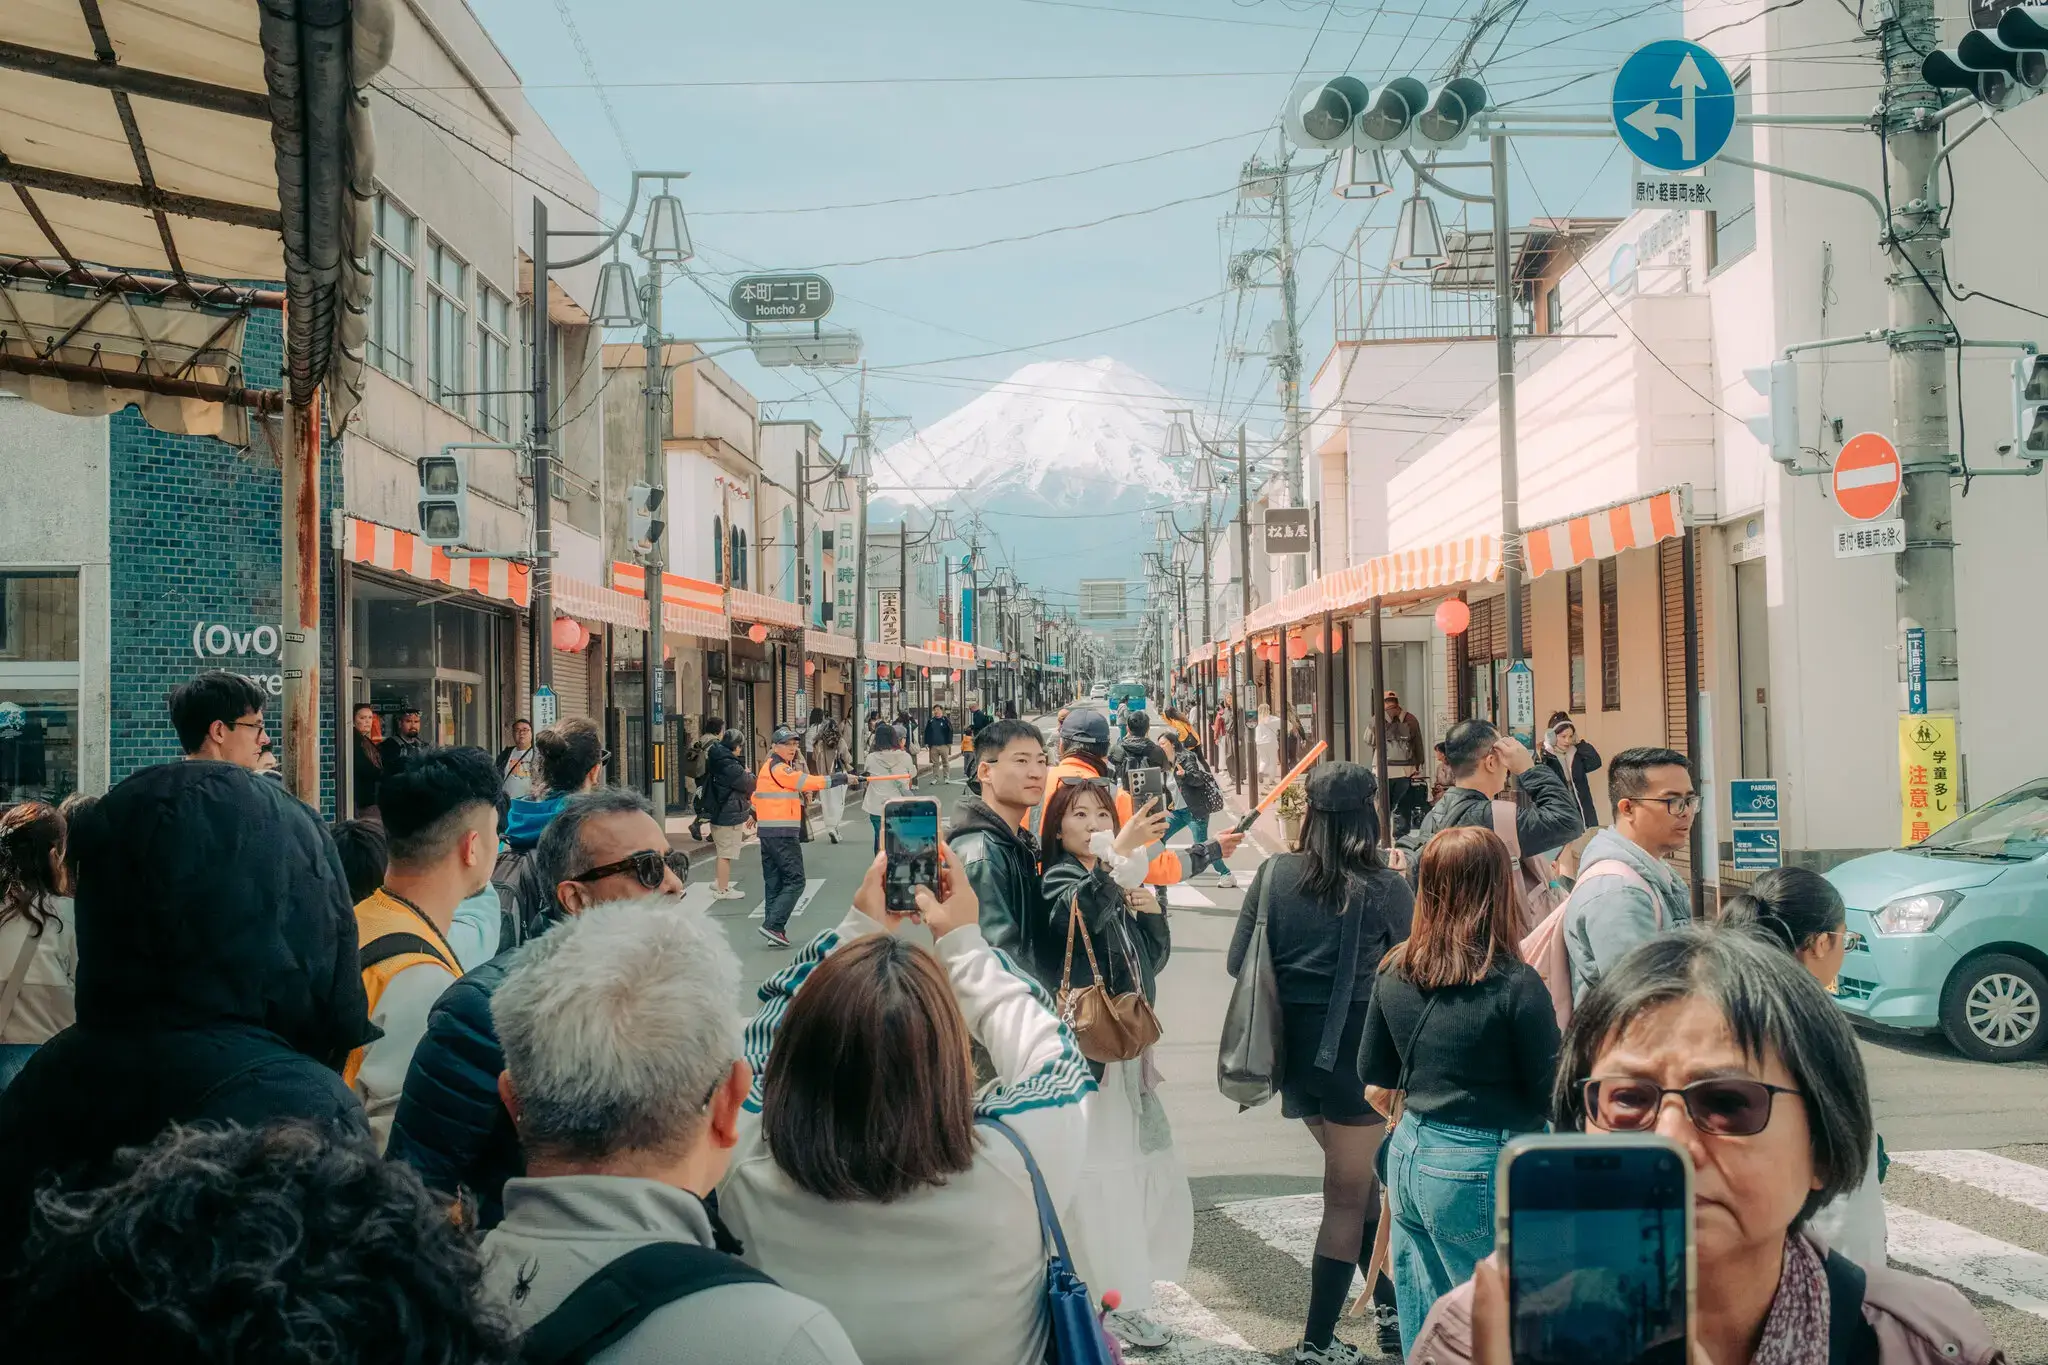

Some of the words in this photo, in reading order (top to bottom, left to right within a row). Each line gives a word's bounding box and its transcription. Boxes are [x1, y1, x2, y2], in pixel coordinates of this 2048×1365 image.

[1636, 182, 1711, 203] 原付・軽車両を除く
[740, 281, 821, 303] 本町二丁目
[756, 304, 796, 315] Honcho
[799, 303, 807, 314] 2
[1839, 527, 1903, 552] 原付・軽車両を除く
[1913, 693, 1921, 705] 6
[1932, 750, 1948, 812] 学童多し
